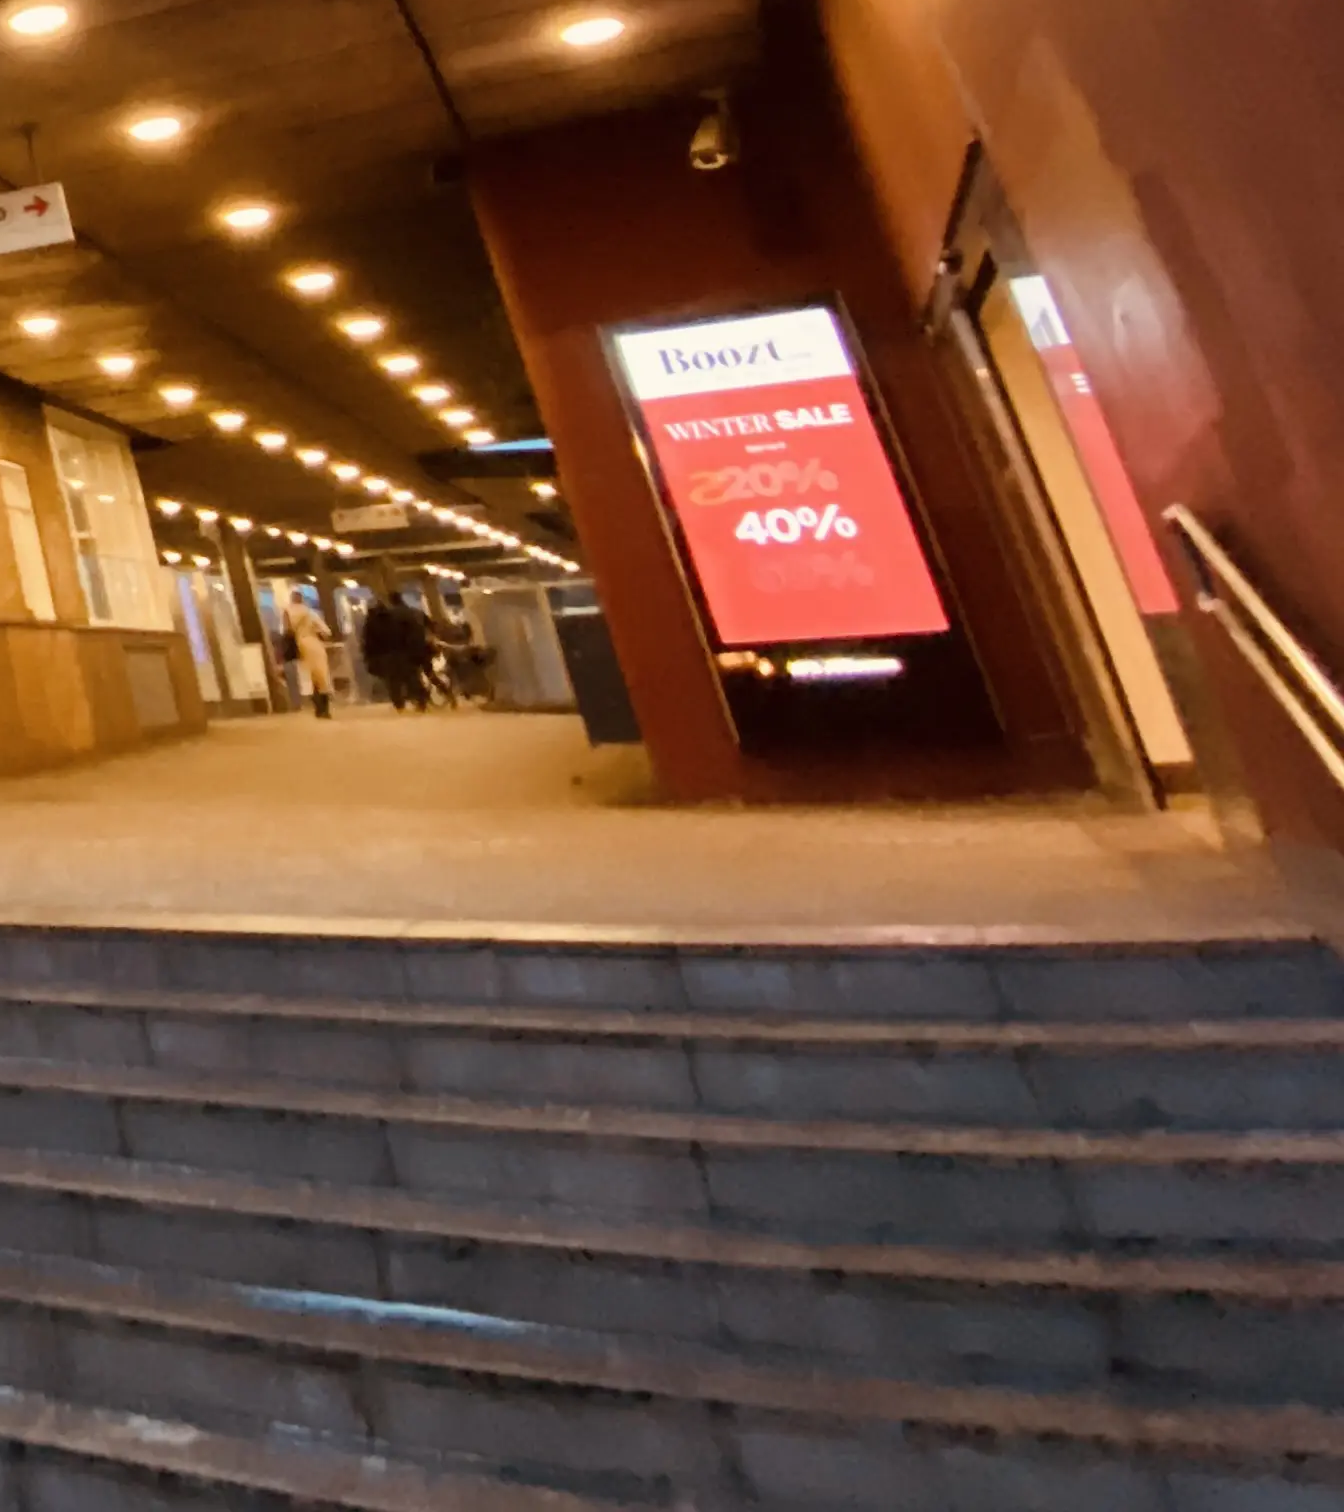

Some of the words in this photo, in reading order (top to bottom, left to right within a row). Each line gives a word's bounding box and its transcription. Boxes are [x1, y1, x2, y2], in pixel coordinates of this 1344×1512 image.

[663, 412, 772, 442] WINTER
[773, 402, 853, 430] SALE
[735, 503, 858, 546] 40%
